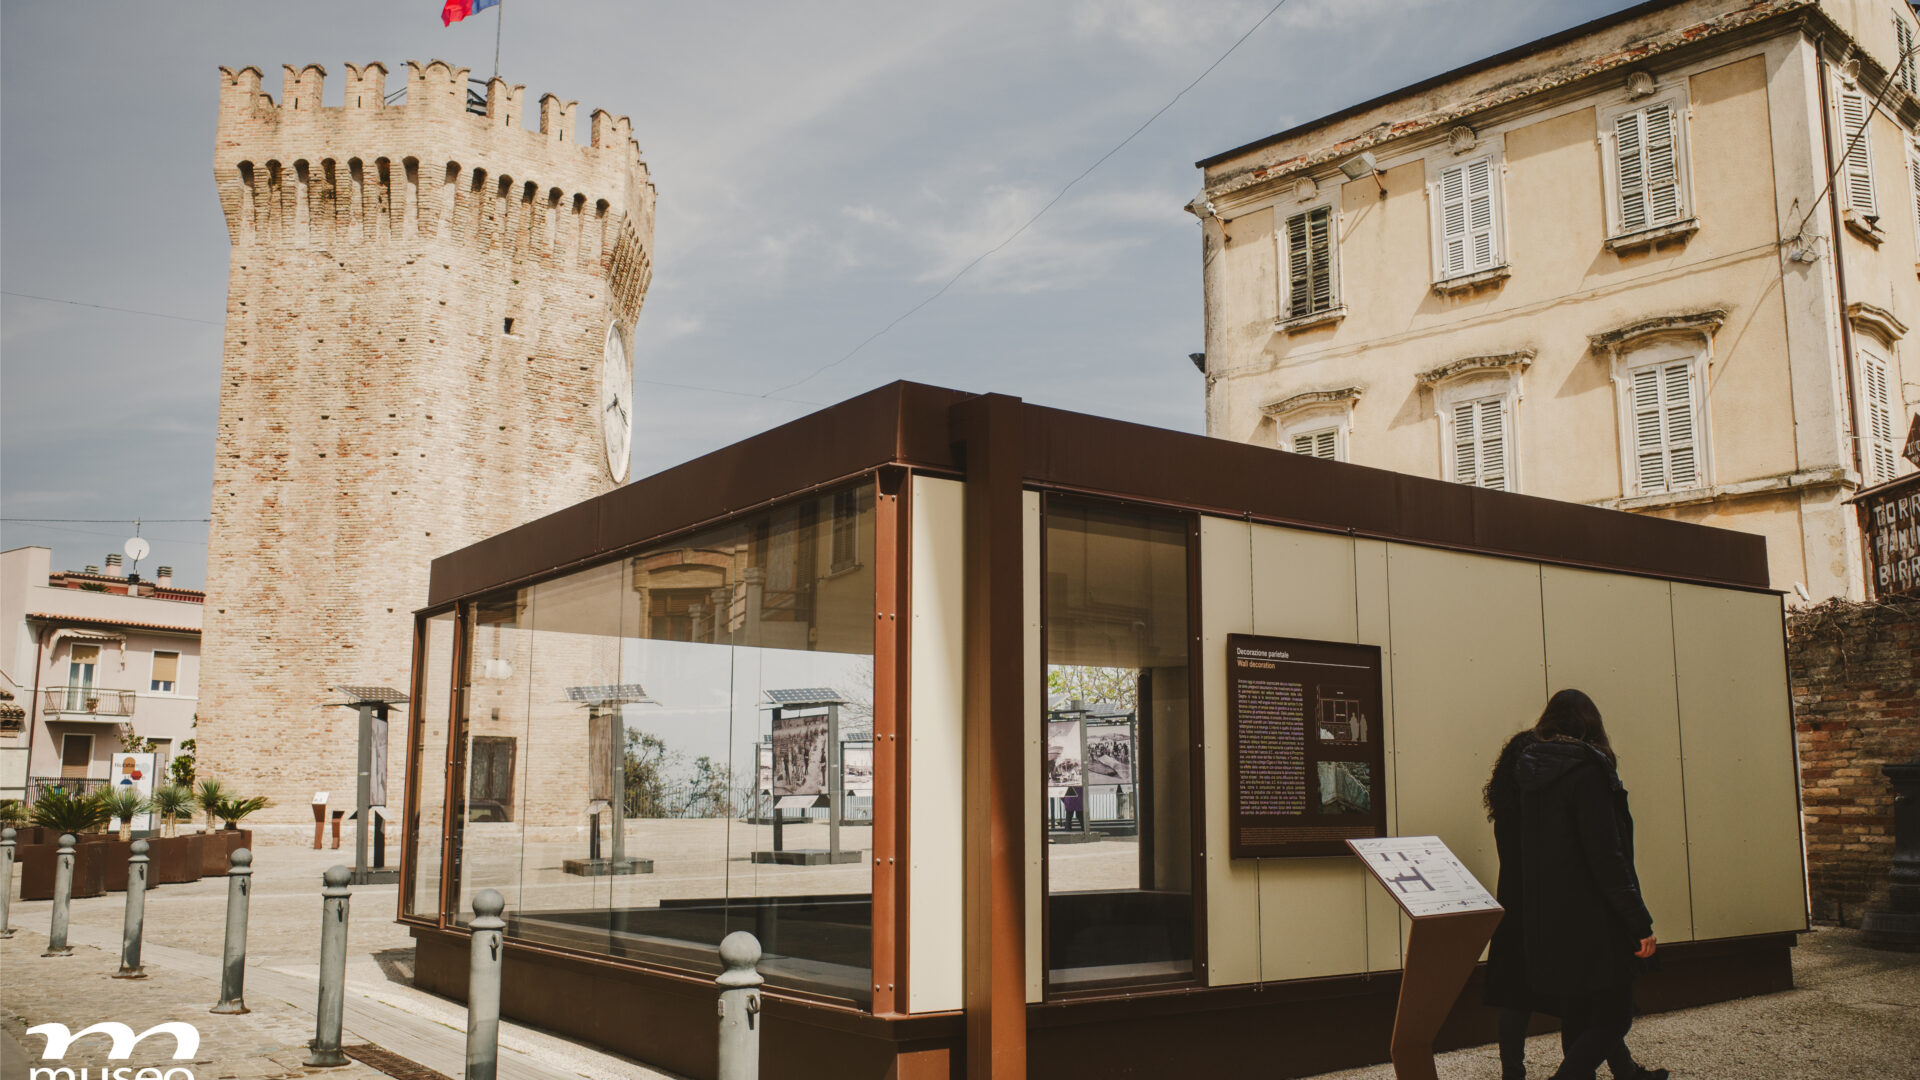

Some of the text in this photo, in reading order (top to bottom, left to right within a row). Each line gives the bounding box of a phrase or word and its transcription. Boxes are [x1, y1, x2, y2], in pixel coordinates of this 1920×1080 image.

[1236, 648, 1289, 659] Decorazione parietale
[1249, 660, 1275, 669] decoration
